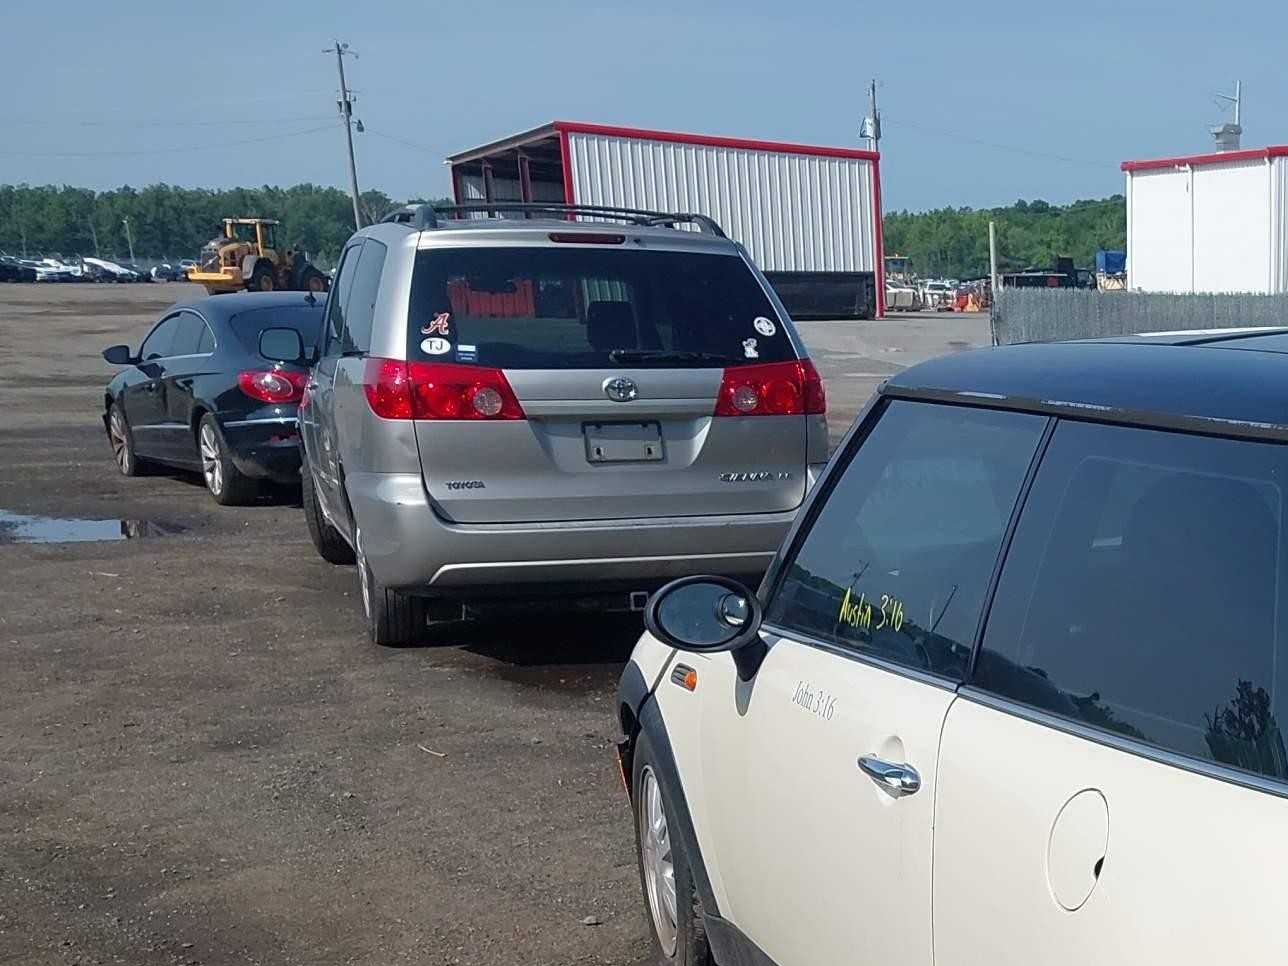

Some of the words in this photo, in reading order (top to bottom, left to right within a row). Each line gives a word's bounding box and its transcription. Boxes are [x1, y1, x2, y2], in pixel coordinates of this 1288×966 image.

[426, 340, 444, 351] TJ
[445, 480, 487, 491] TOYOTA
[839, 587, 872, 630] Austin
[876, 594, 904, 632] 3:16
[792, 680, 814, 711] John
[813, 690, 838, 721] 3:16
